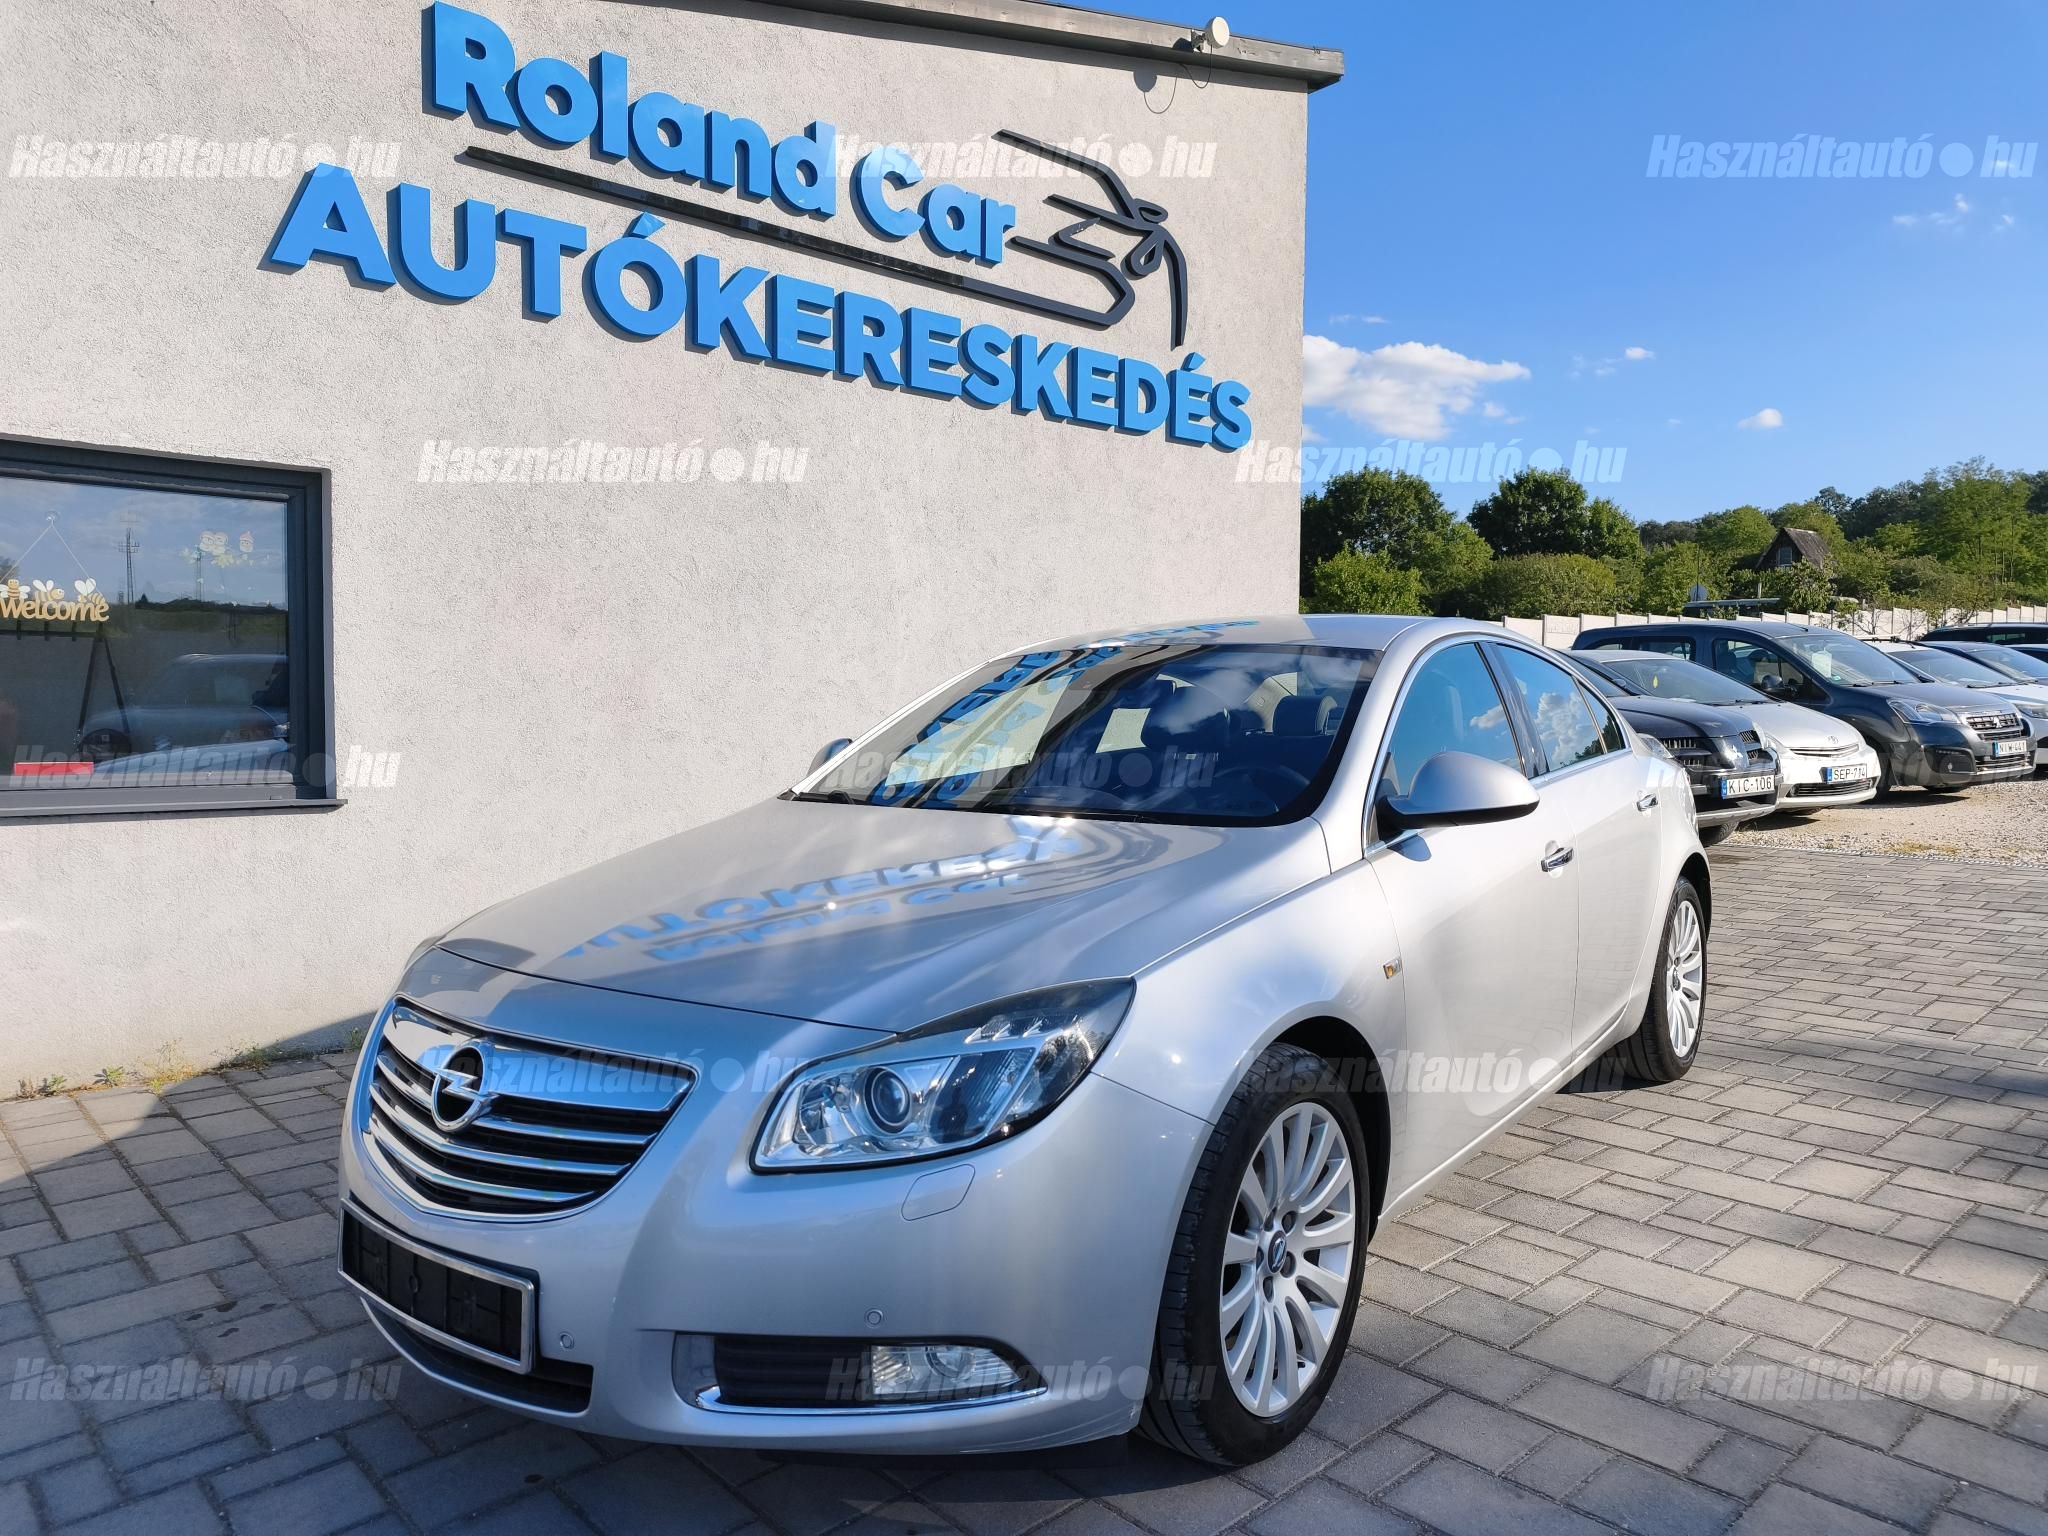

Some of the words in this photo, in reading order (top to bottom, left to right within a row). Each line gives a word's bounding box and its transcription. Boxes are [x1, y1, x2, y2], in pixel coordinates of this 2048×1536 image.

[432, 2, 836, 217] Roland
[854, 145, 1016, 266] Car
[271, 162, 1252, 450] AUTÓKERESKEDÉS
[0, 597, 110, 622] Welcome
[1728, 776, 1772, 794] KIC-106
